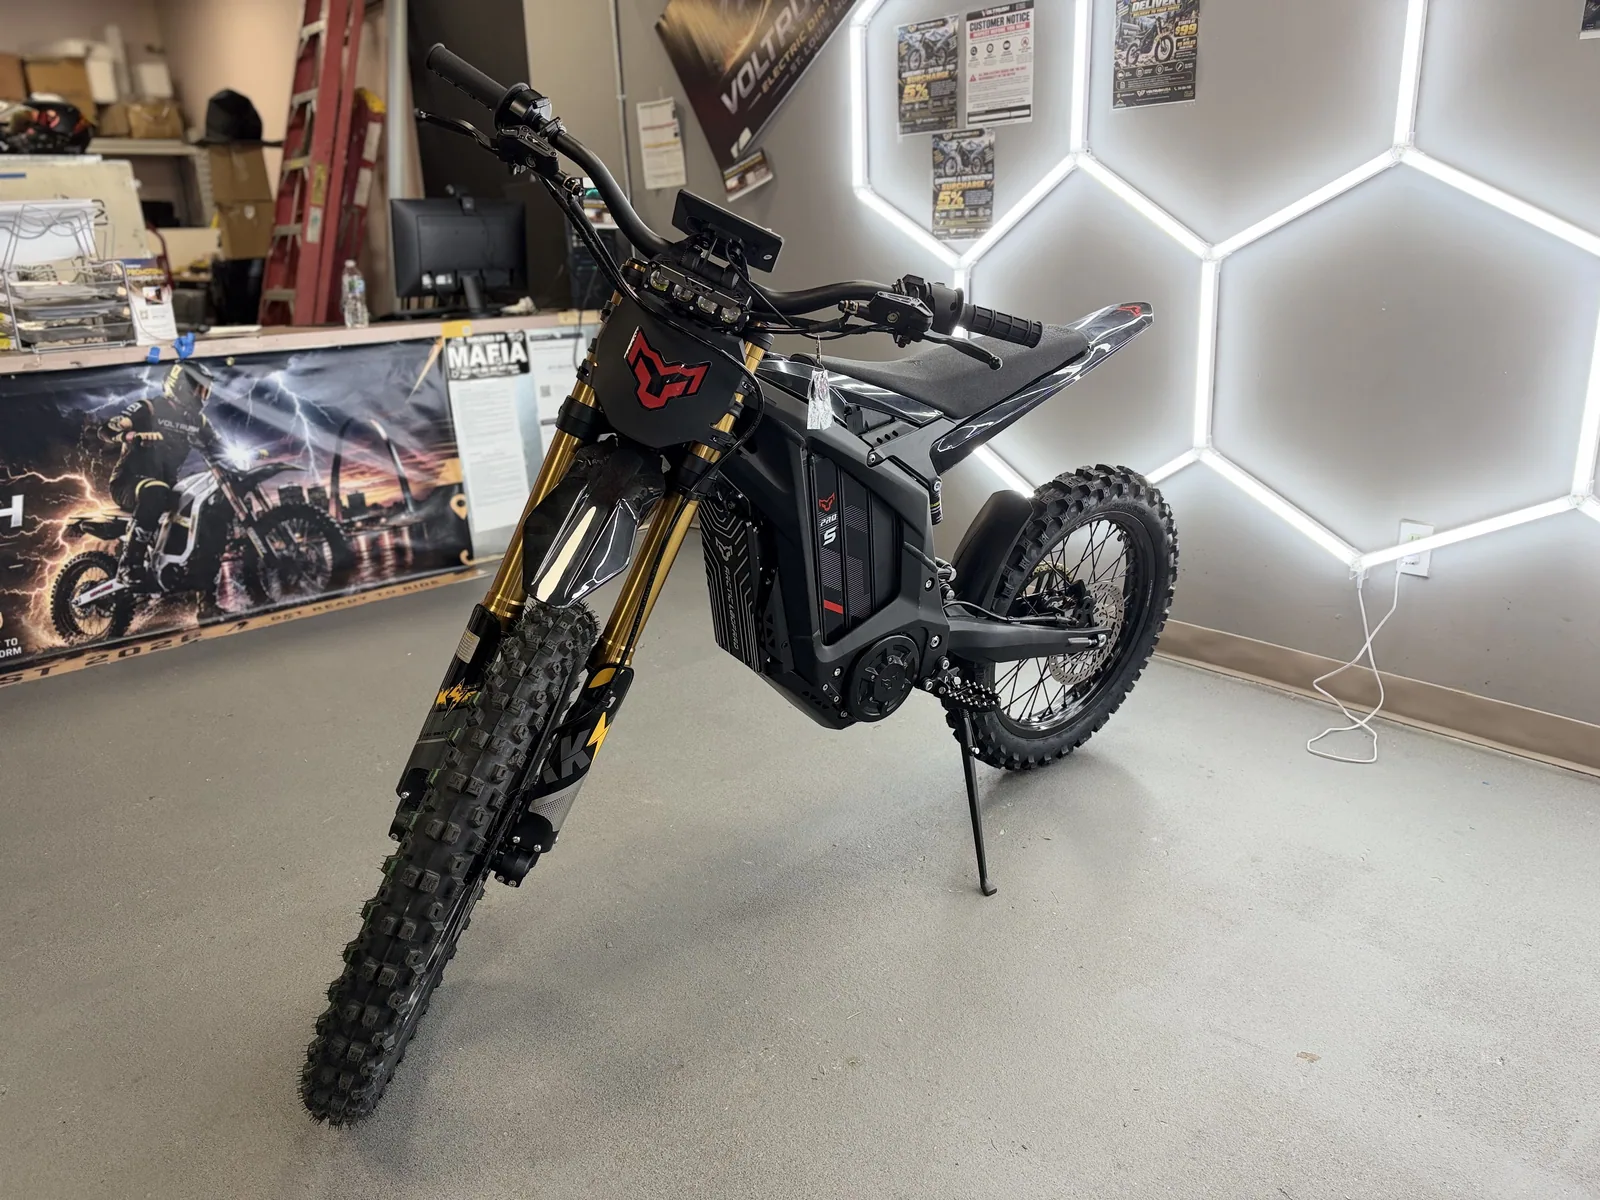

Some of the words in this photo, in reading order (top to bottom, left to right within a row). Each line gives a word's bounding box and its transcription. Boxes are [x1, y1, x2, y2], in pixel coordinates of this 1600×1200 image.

[970, 17, 1005, 31] CUSTOMER
[1006, 11, 1030, 24] NOTICE
[1175, 23, 1198, 36] $99
[761, 30, 807, 94] ELECTRIC
[806, 0, 831, 31] DIRT
[720, 0, 813, 115] VOLTRU
[790, 56, 804, 75] ST.
[907, 71, 949, 85] SURCHARGE
[904, 82, 929, 97] 5%
[942, 181, 985, 191] SURCHARGE
[938, 190, 964, 205] 5%
[447, 341, 528, 368] MAFIA
[157, 419, 200, 433] VOLTRUSH
[820, 513, 837, 527] PRO
[823, 525, 838, 546] S
[724, 565, 734, 604] ARCTIC
[728, 604, 740, 650] LEOPARD
[4, 637, 18, 647] TO
